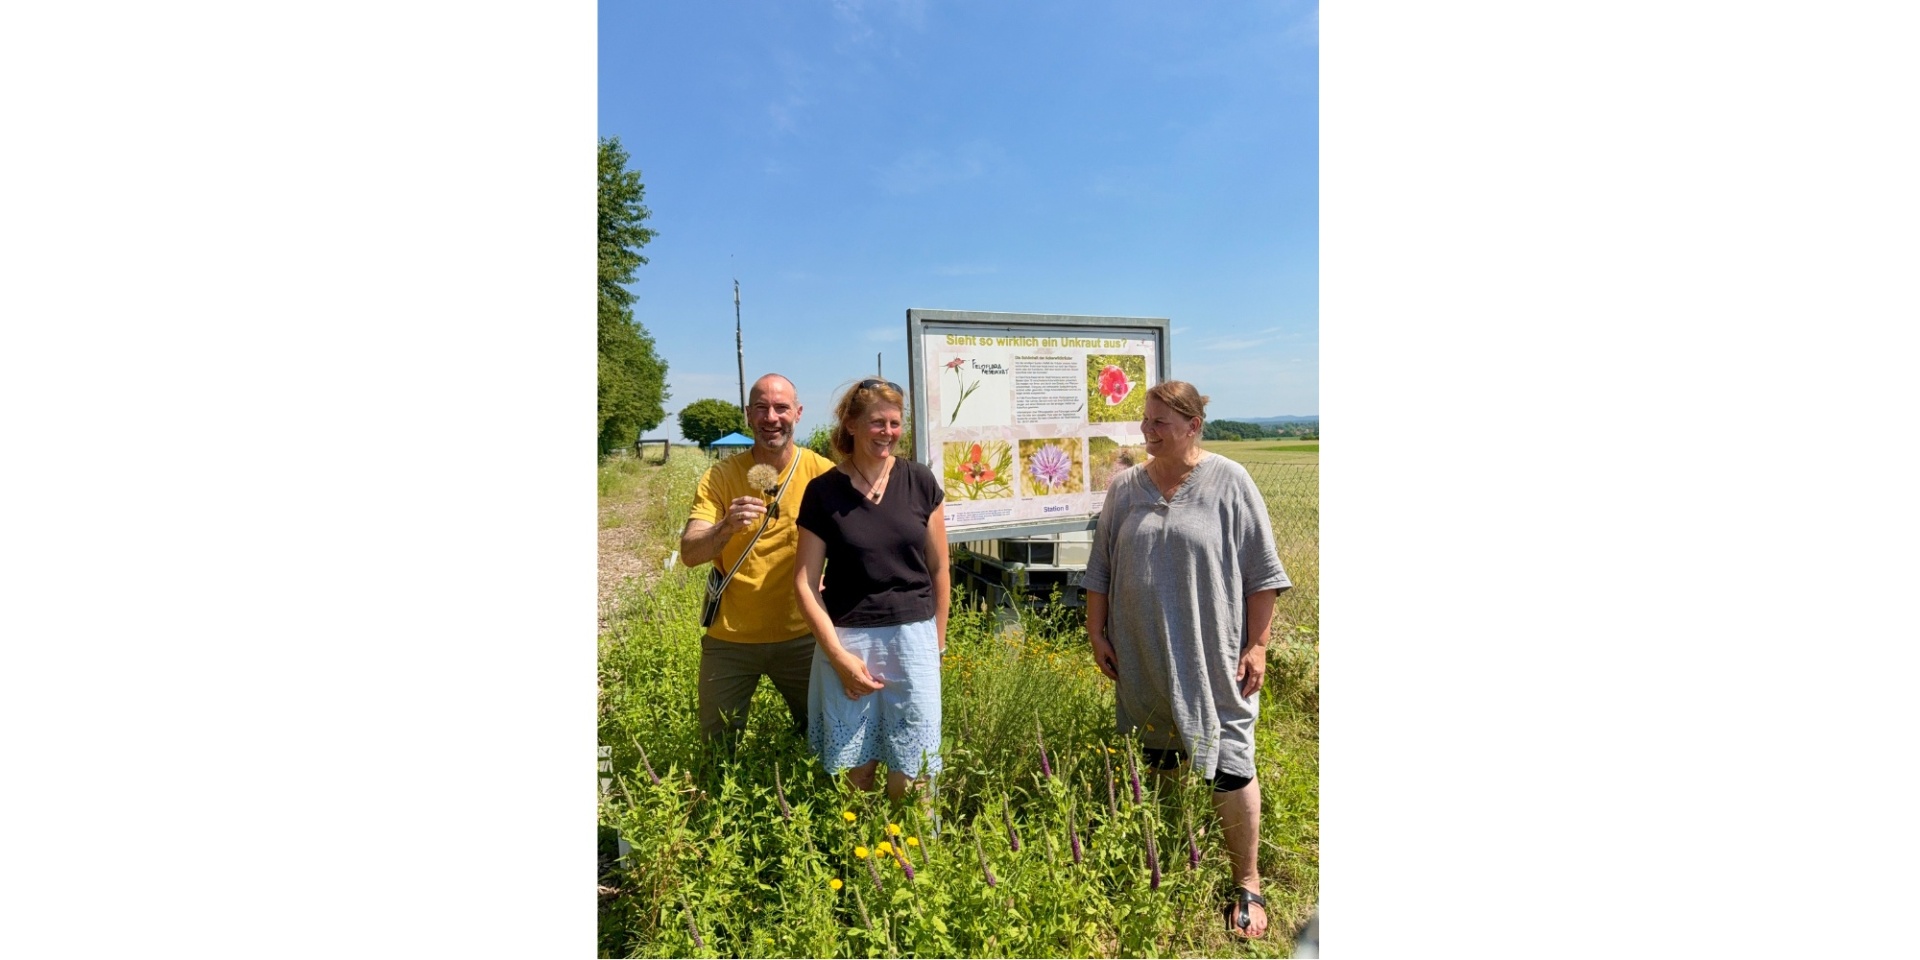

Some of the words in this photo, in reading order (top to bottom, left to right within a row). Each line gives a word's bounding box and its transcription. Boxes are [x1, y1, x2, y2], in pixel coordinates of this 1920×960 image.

[946, 334, 976, 346] Sieht
[979, 336, 994, 346] so
[996, 336, 1038, 347] wirklich
[1042, 336, 1058, 347] ein
[1060, 336, 1101, 348] Unkraut
[1104, 338, 1127, 348] aus?
[1044, 504, 1064, 512] Station
